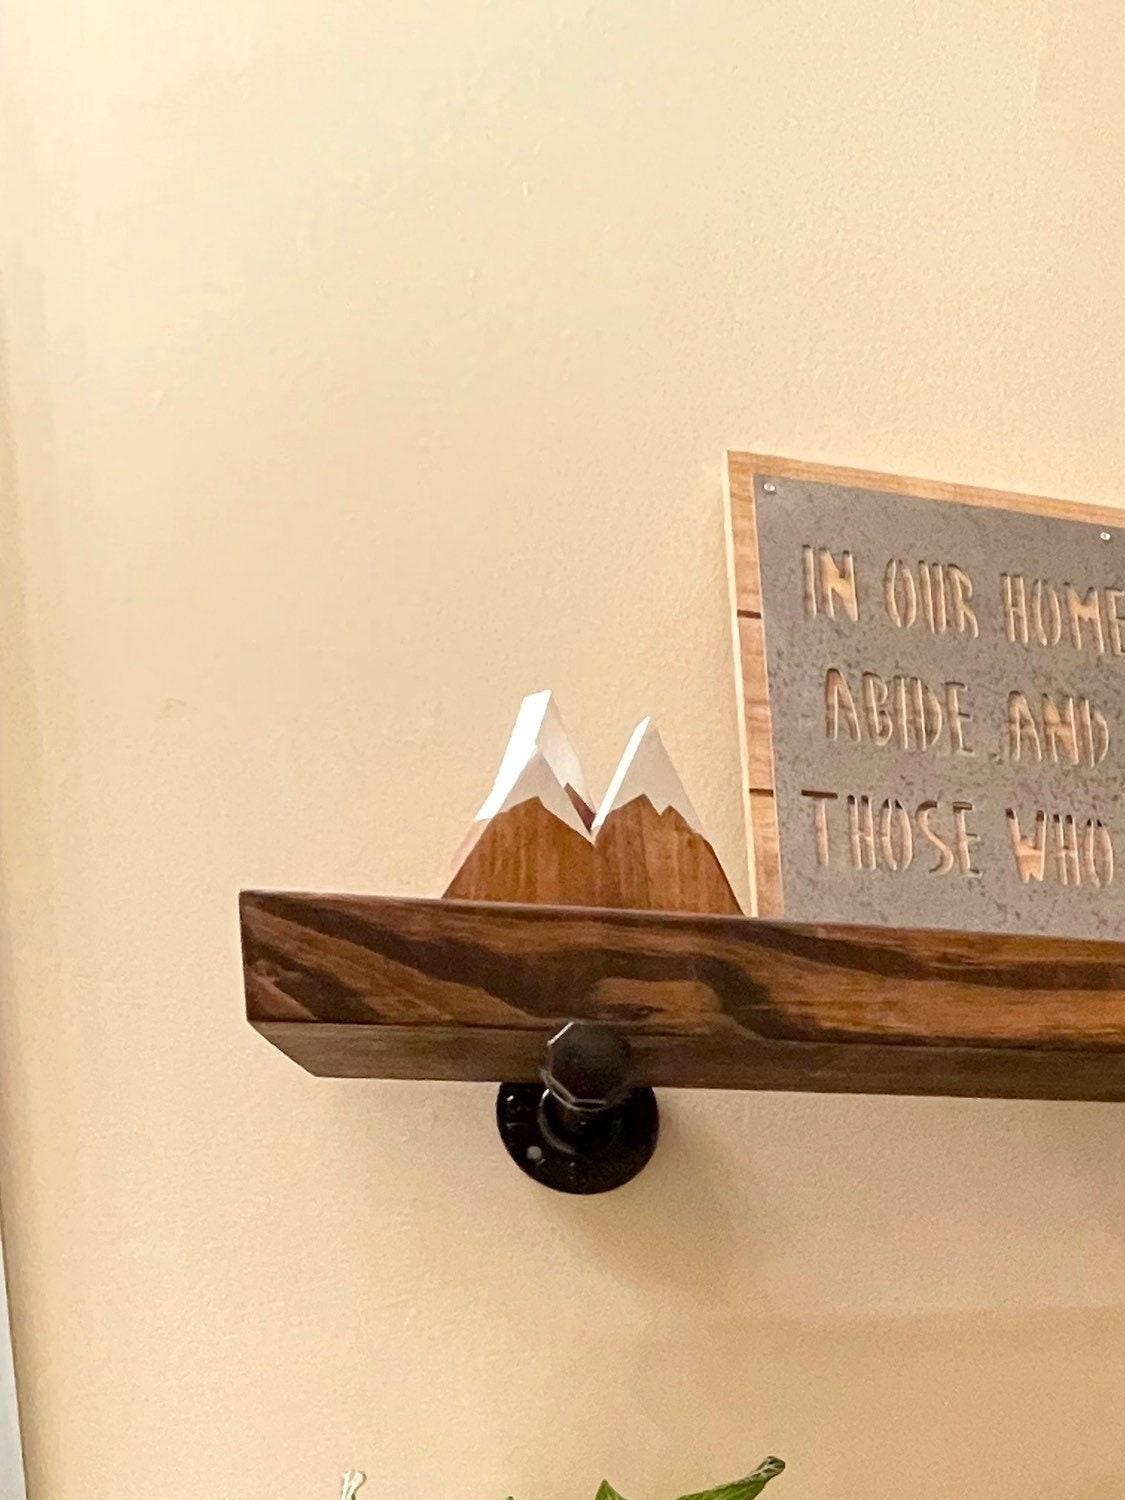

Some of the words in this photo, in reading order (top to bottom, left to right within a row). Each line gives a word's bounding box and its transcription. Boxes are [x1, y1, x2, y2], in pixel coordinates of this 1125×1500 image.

[803, 544, 859, 622] IN
[885, 558, 979, 639] OUR
[824, 668, 975, 757] ABIDE
[1009, 690, 1110, 770] AND
[801, 789, 983, 879] THOSE
[1006, 808, 1115, 889] WHO
